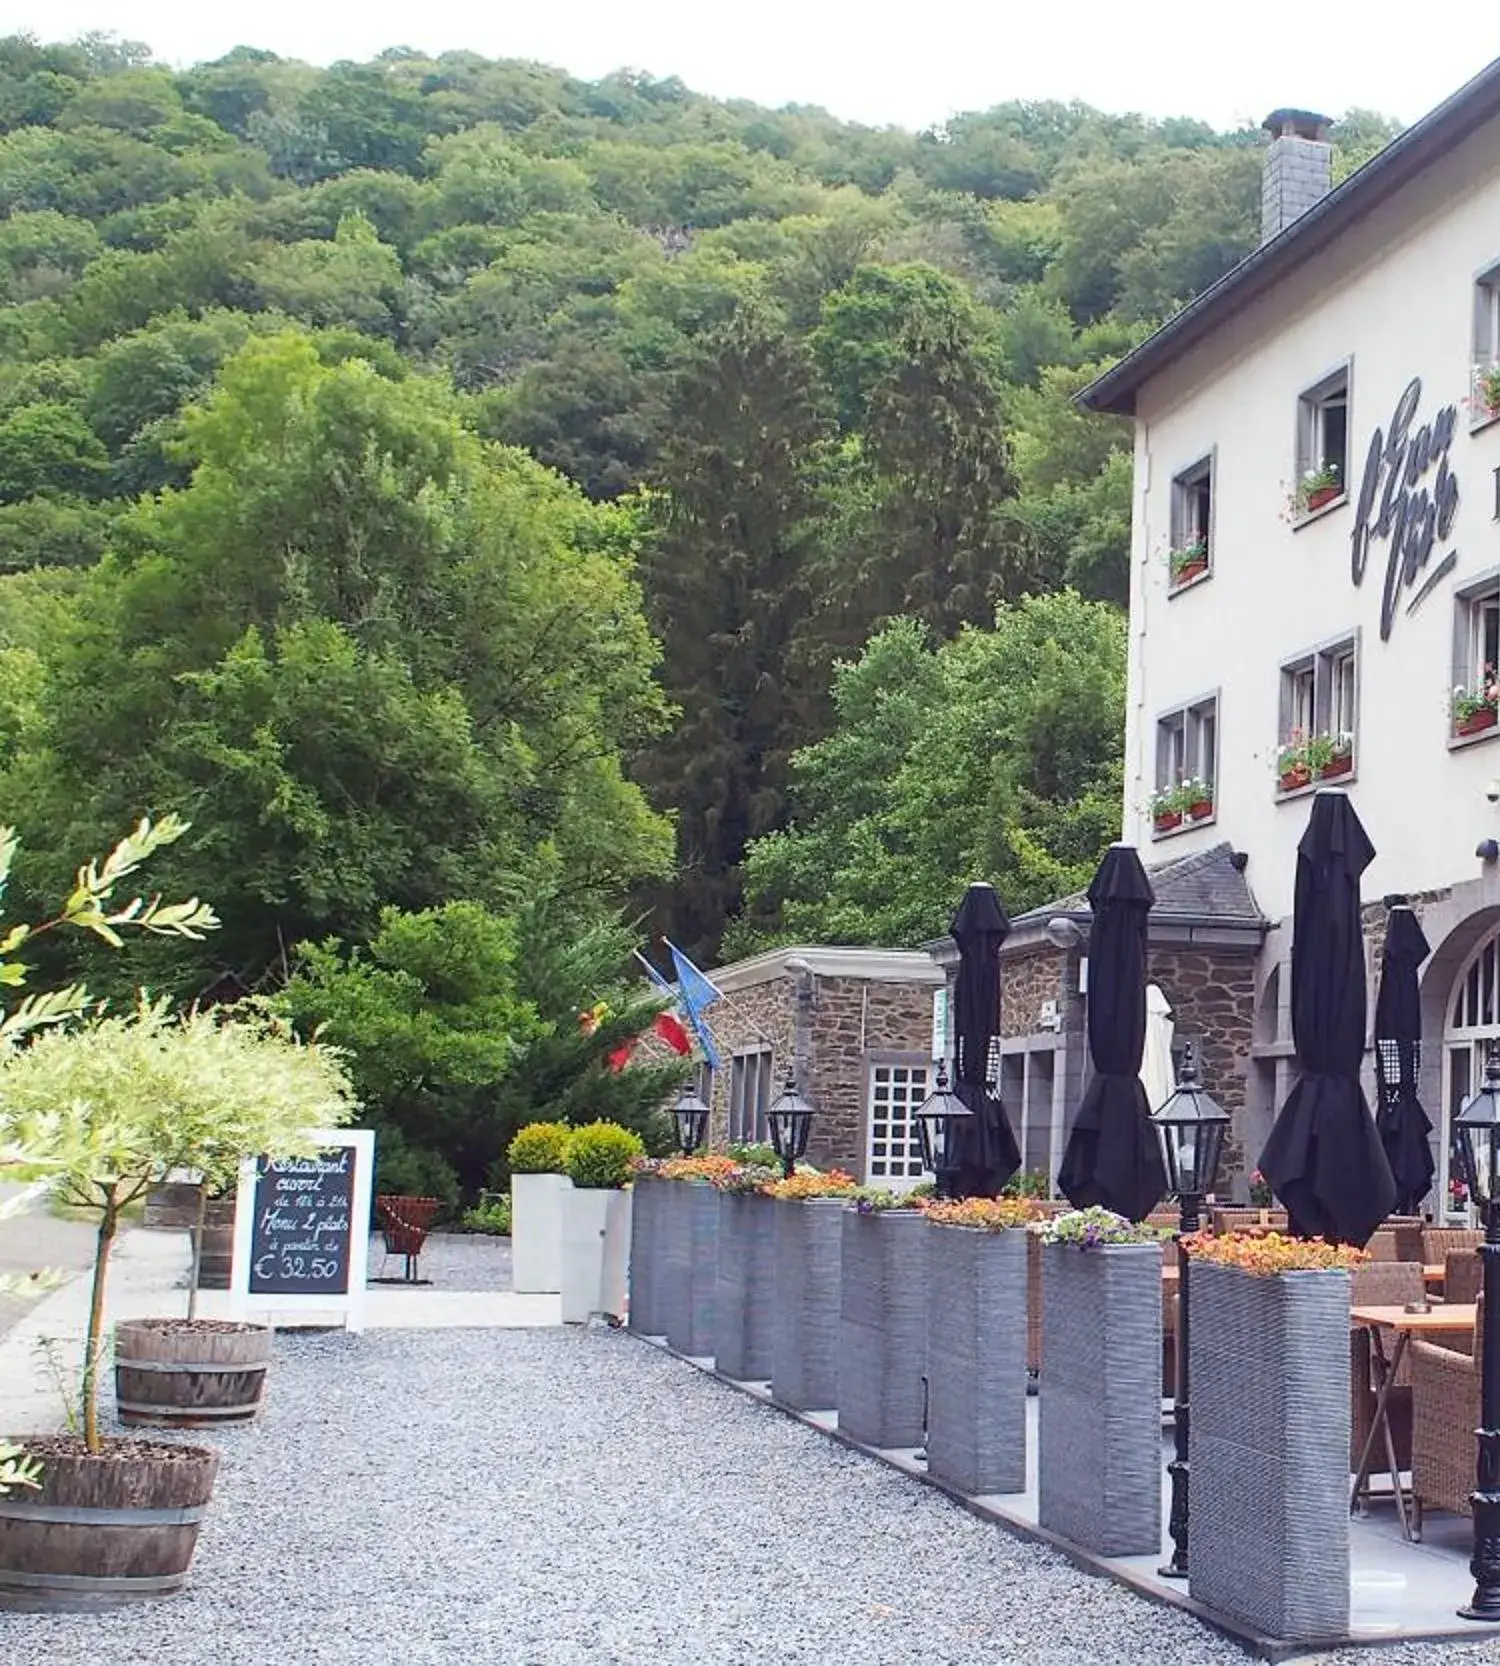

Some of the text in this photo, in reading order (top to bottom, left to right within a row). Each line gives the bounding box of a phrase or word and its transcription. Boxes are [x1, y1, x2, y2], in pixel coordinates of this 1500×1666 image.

[260, 1207, 349, 1242] Menu 2 plats
[253, 1253, 340, 1280] € 32,50
